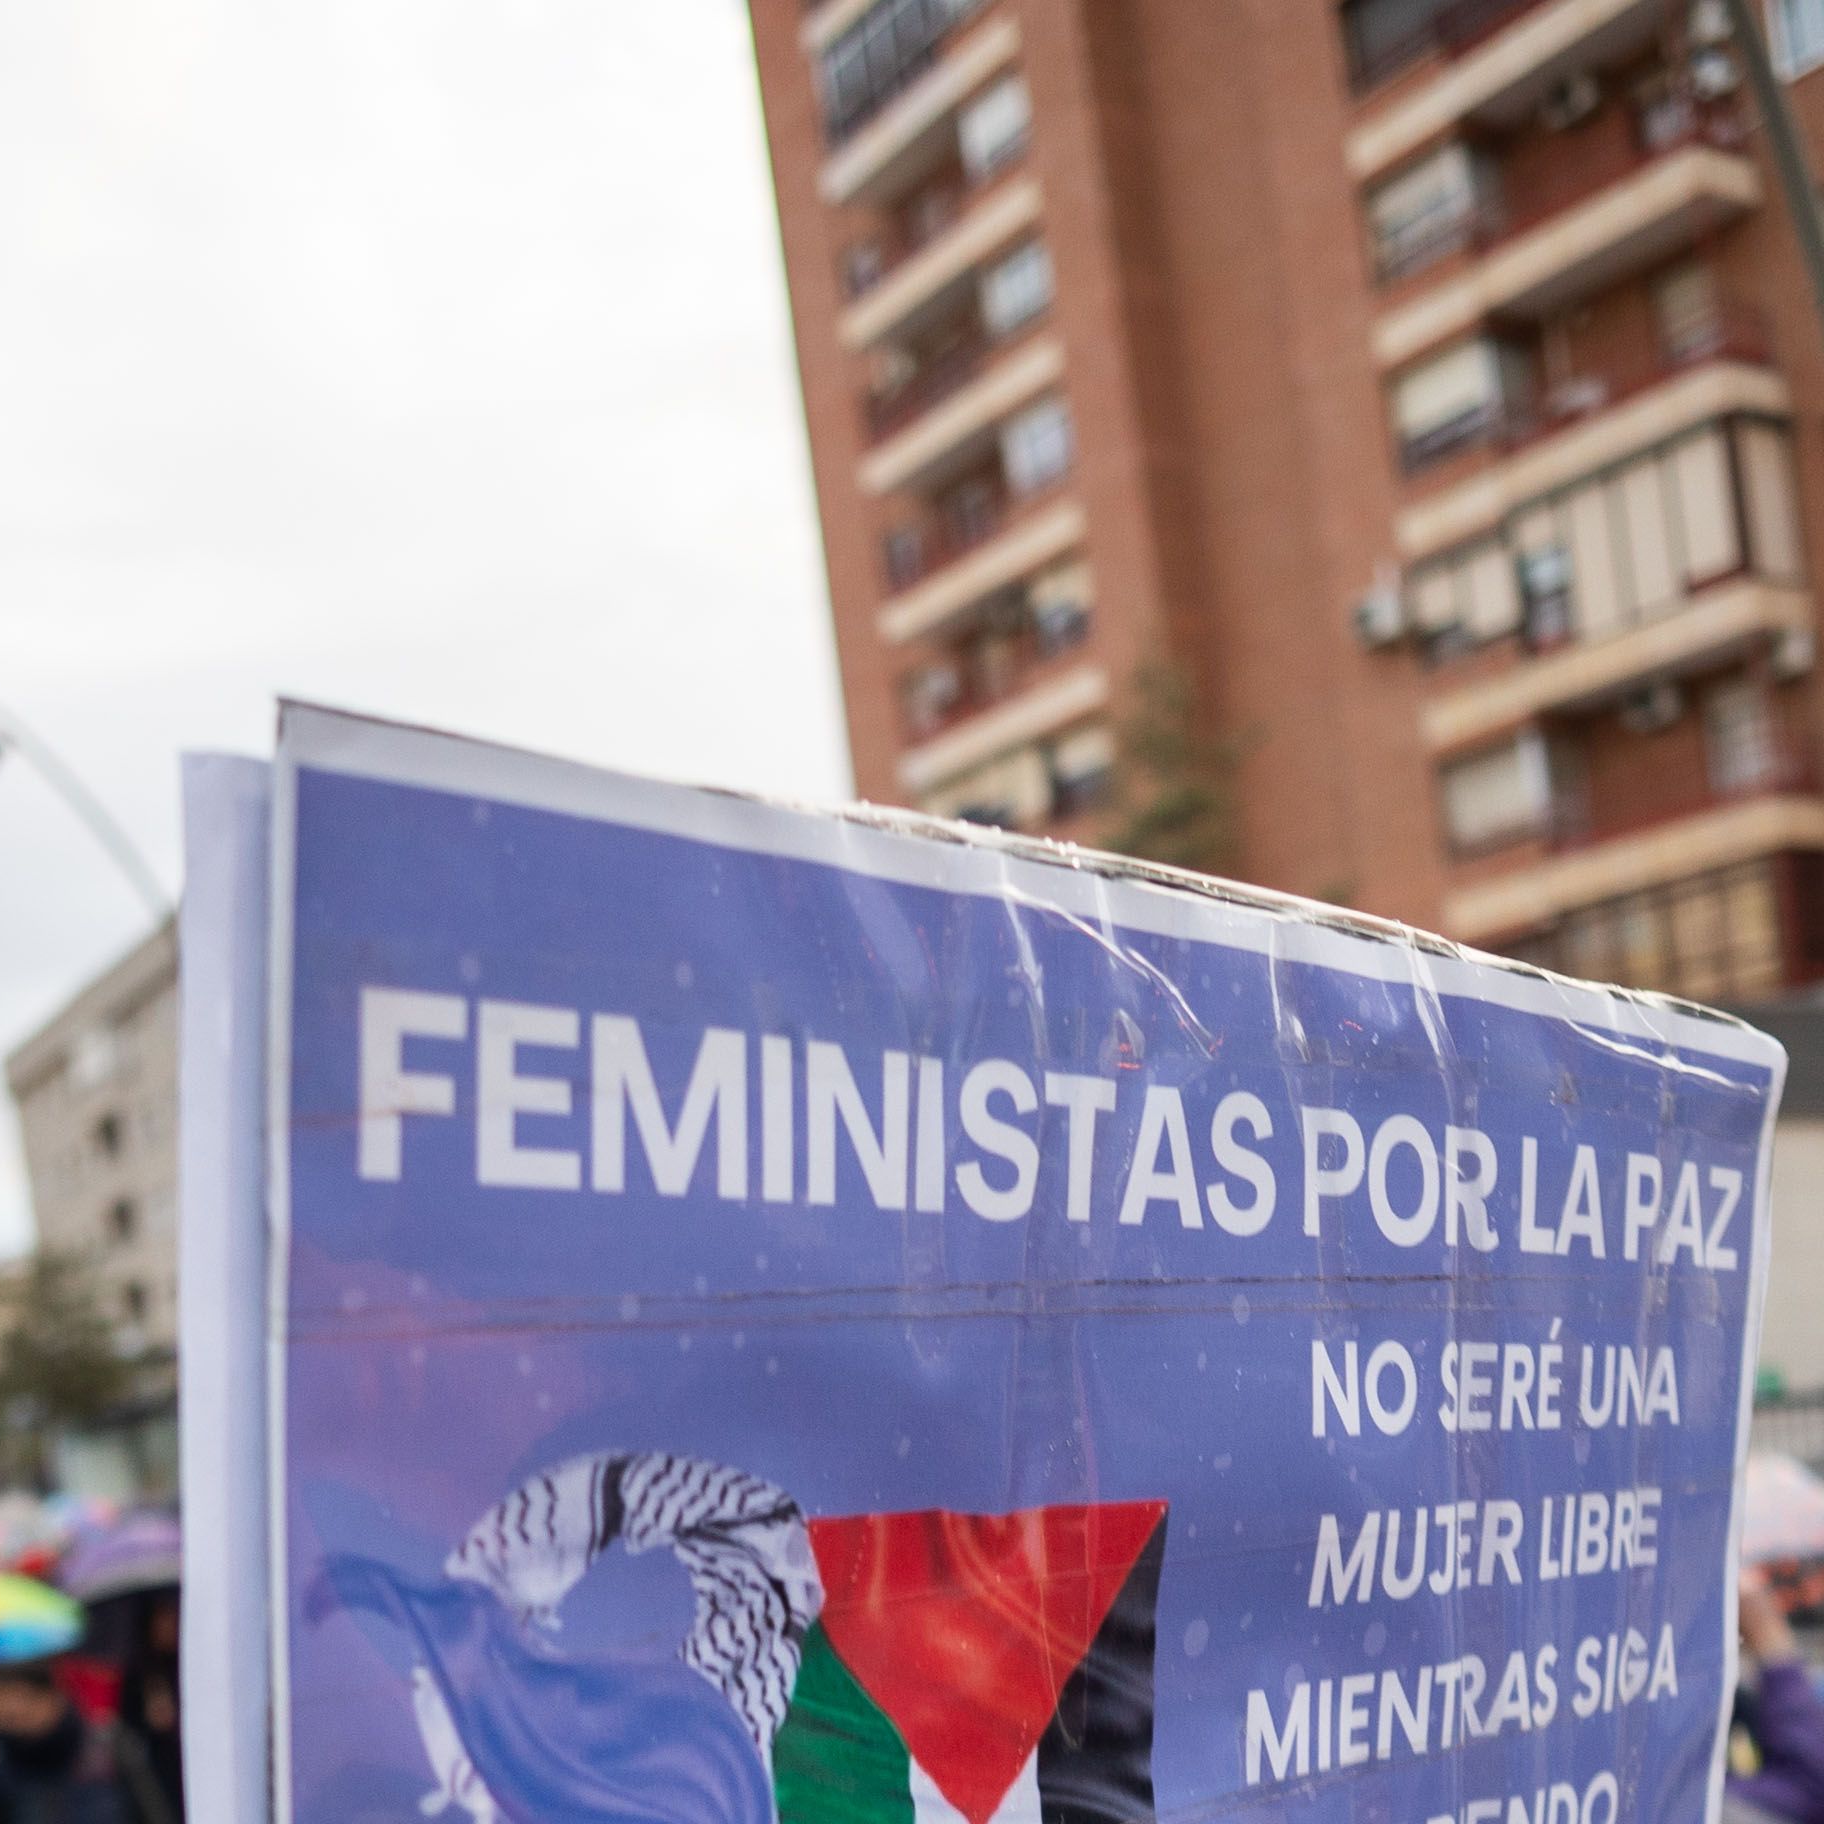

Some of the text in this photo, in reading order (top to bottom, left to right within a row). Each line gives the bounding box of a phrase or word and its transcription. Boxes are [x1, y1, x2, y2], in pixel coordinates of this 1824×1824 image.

[359, 985, 1743, 1272] FEMINISTAS POR LA PAZ
[1311, 1317, 1680, 1437] NO SERÉ UNA
[1308, 1488, 1662, 1608] MUJER LIBRE
[1246, 1622, 1678, 1785] MIENTRAS SIGA
